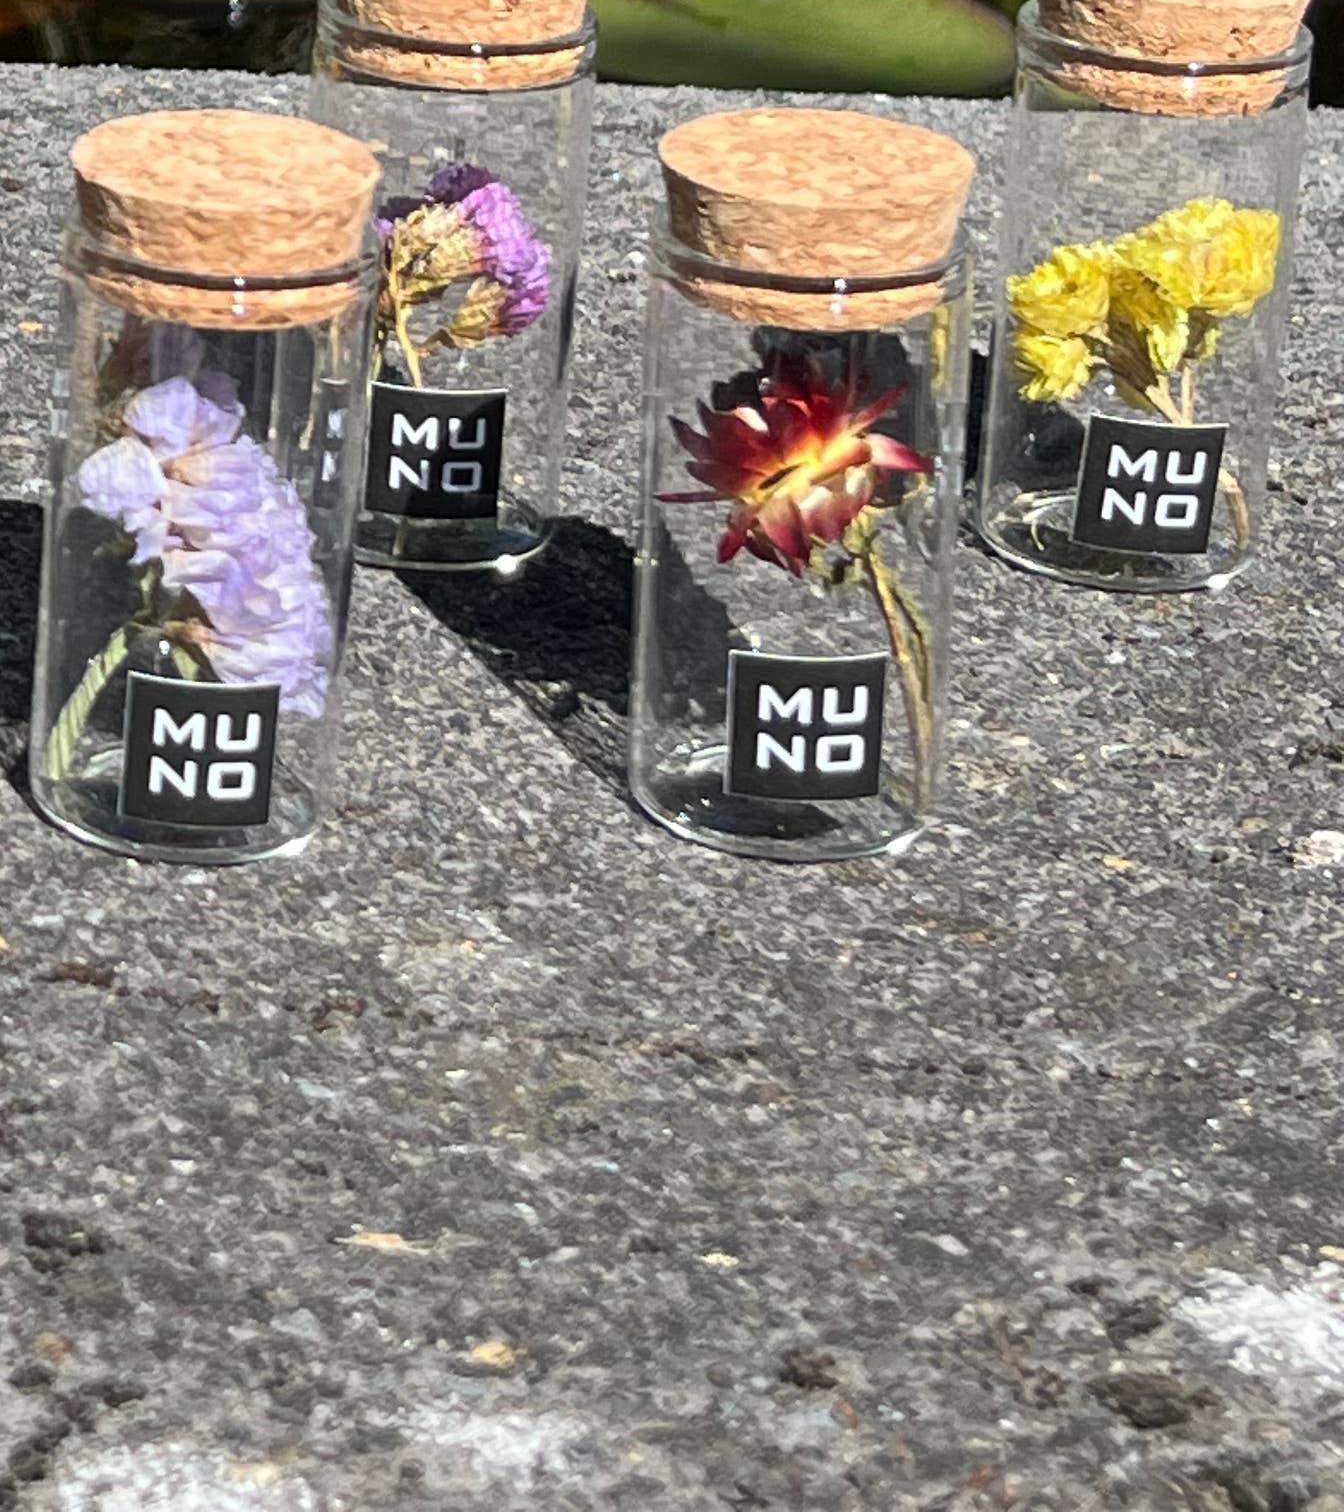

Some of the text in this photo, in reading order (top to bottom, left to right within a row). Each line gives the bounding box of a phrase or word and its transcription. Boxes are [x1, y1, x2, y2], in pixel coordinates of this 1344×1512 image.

[391, 413, 486, 452] MU
[388, 455, 482, 493] NO
[1107, 444, 1207, 485] MU
[1101, 487, 1199, 529] NO
[758, 684, 869, 726] MU
[153, 708, 261, 753] MU
[756, 732, 865, 773] NO
[148, 755, 256, 801] NO
